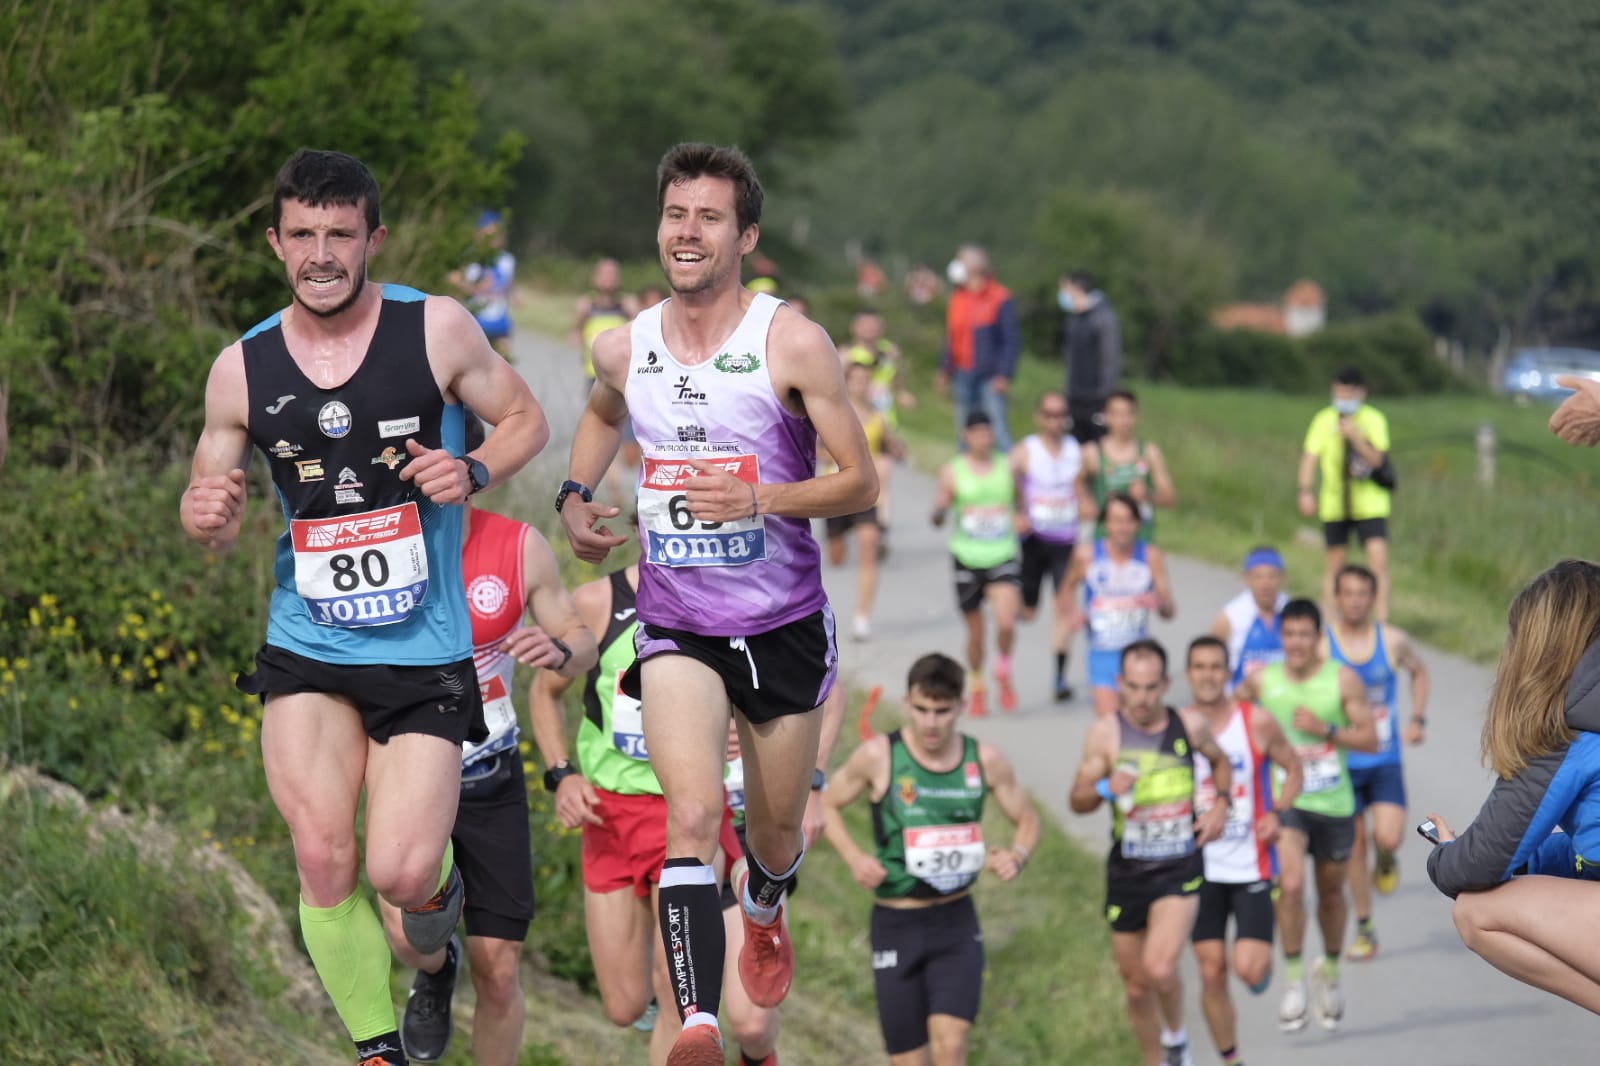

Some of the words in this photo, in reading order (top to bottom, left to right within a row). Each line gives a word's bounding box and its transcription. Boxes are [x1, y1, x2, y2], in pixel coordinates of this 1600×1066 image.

[637, 365, 664, 374] VIATOR
[337, 511, 402, 536] RFEA
[336, 528, 399, 545] ATLETISMO
[329, 548, 390, 592] 80
[931, 850, 963, 873] 30
